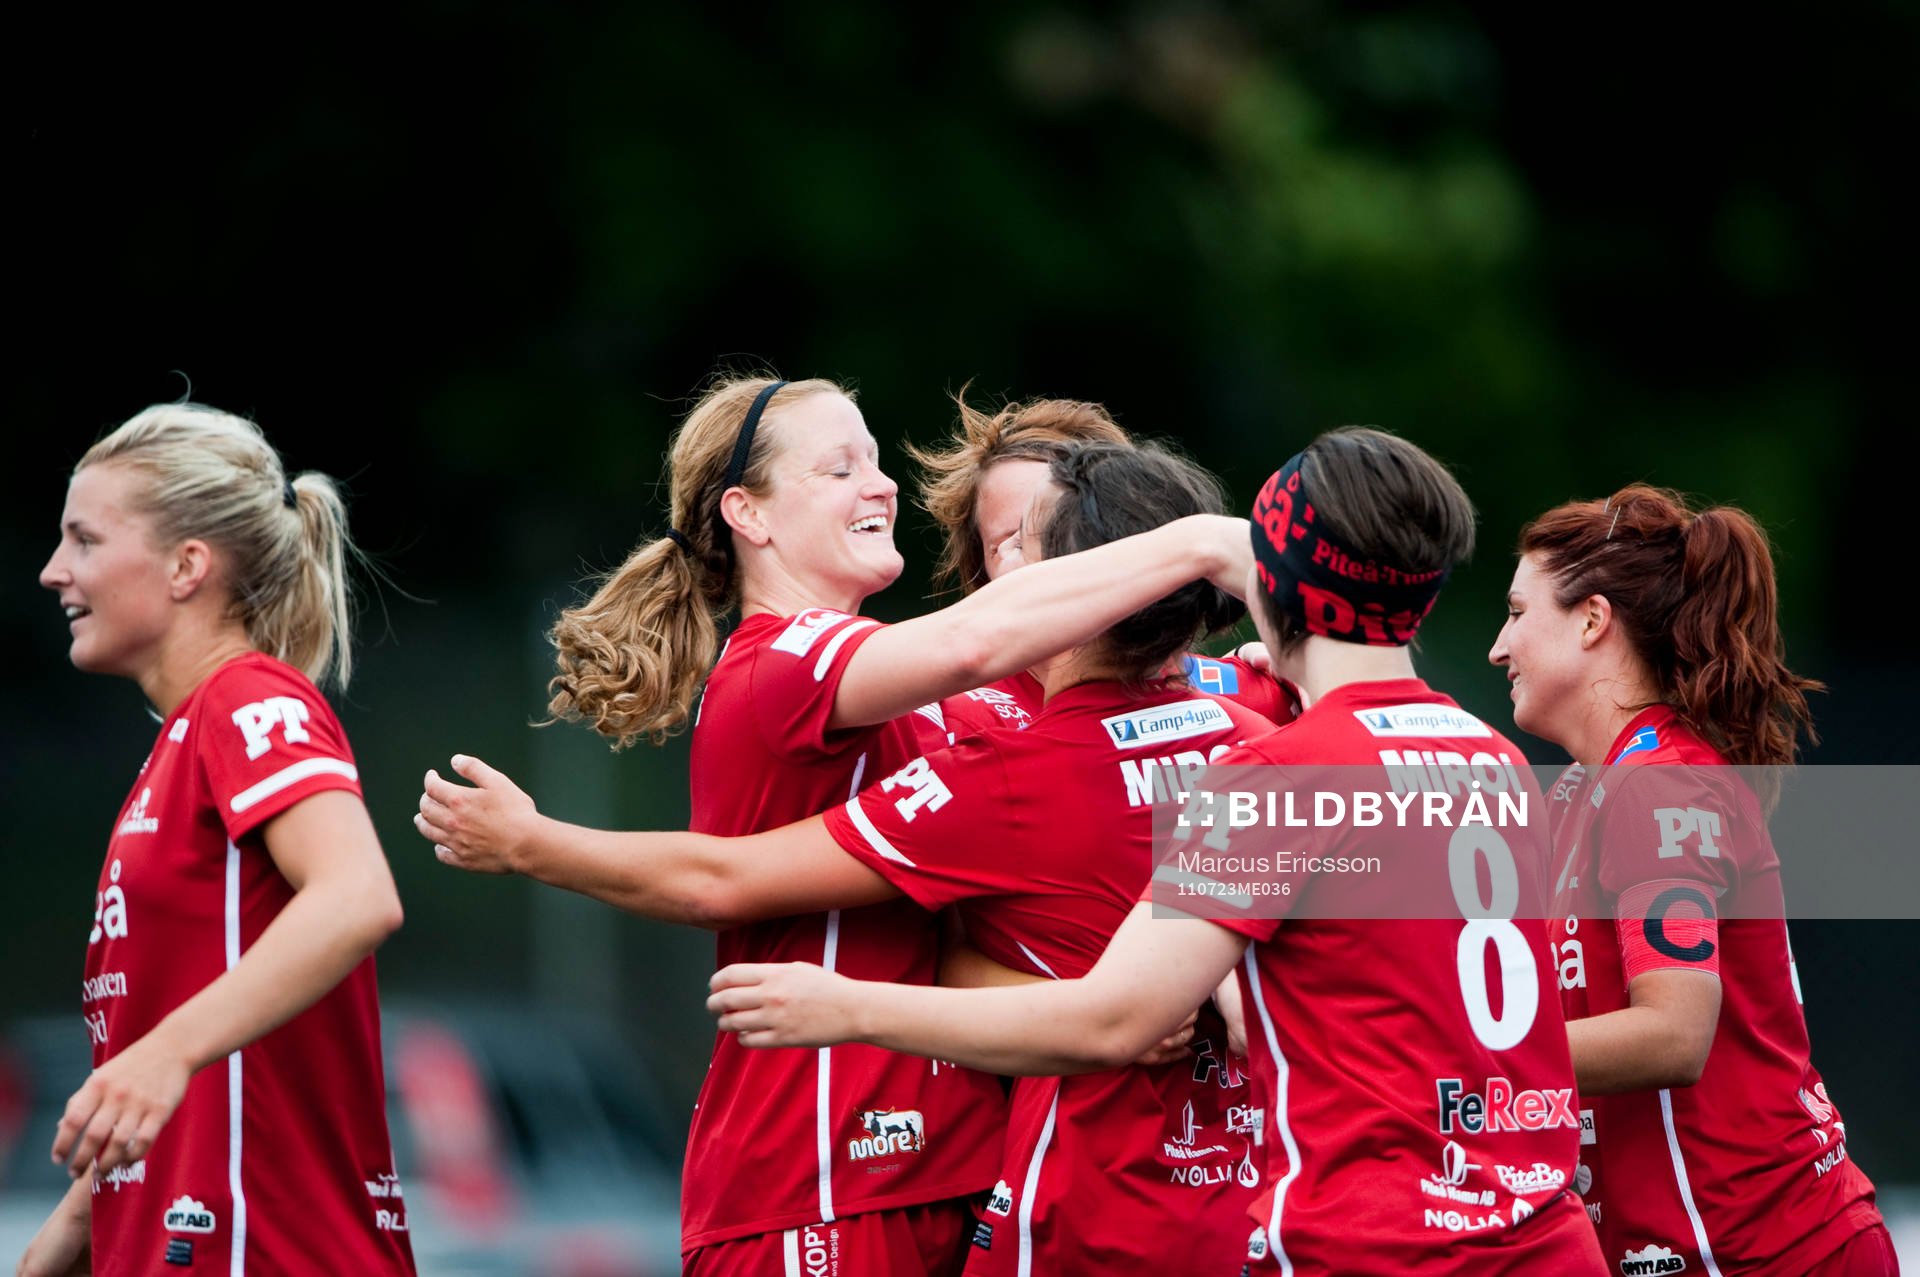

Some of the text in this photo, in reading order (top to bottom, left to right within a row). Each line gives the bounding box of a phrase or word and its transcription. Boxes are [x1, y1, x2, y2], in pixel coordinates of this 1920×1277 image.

[231, 696, 310, 761] PT
[1138, 709, 1223, 734] Camp4you
[880, 756, 953, 823] PT
[1653, 806, 1722, 859] PT
[1448, 821, 1540, 1051] 8
[1643, 887, 1716, 963] C
[1436, 1077, 1579, 1135] FeRex
[848, 1130, 913, 1161] more
[1494, 1162, 1566, 1187] PiteBo
[1424, 1208, 1507, 1233] NOLIA
